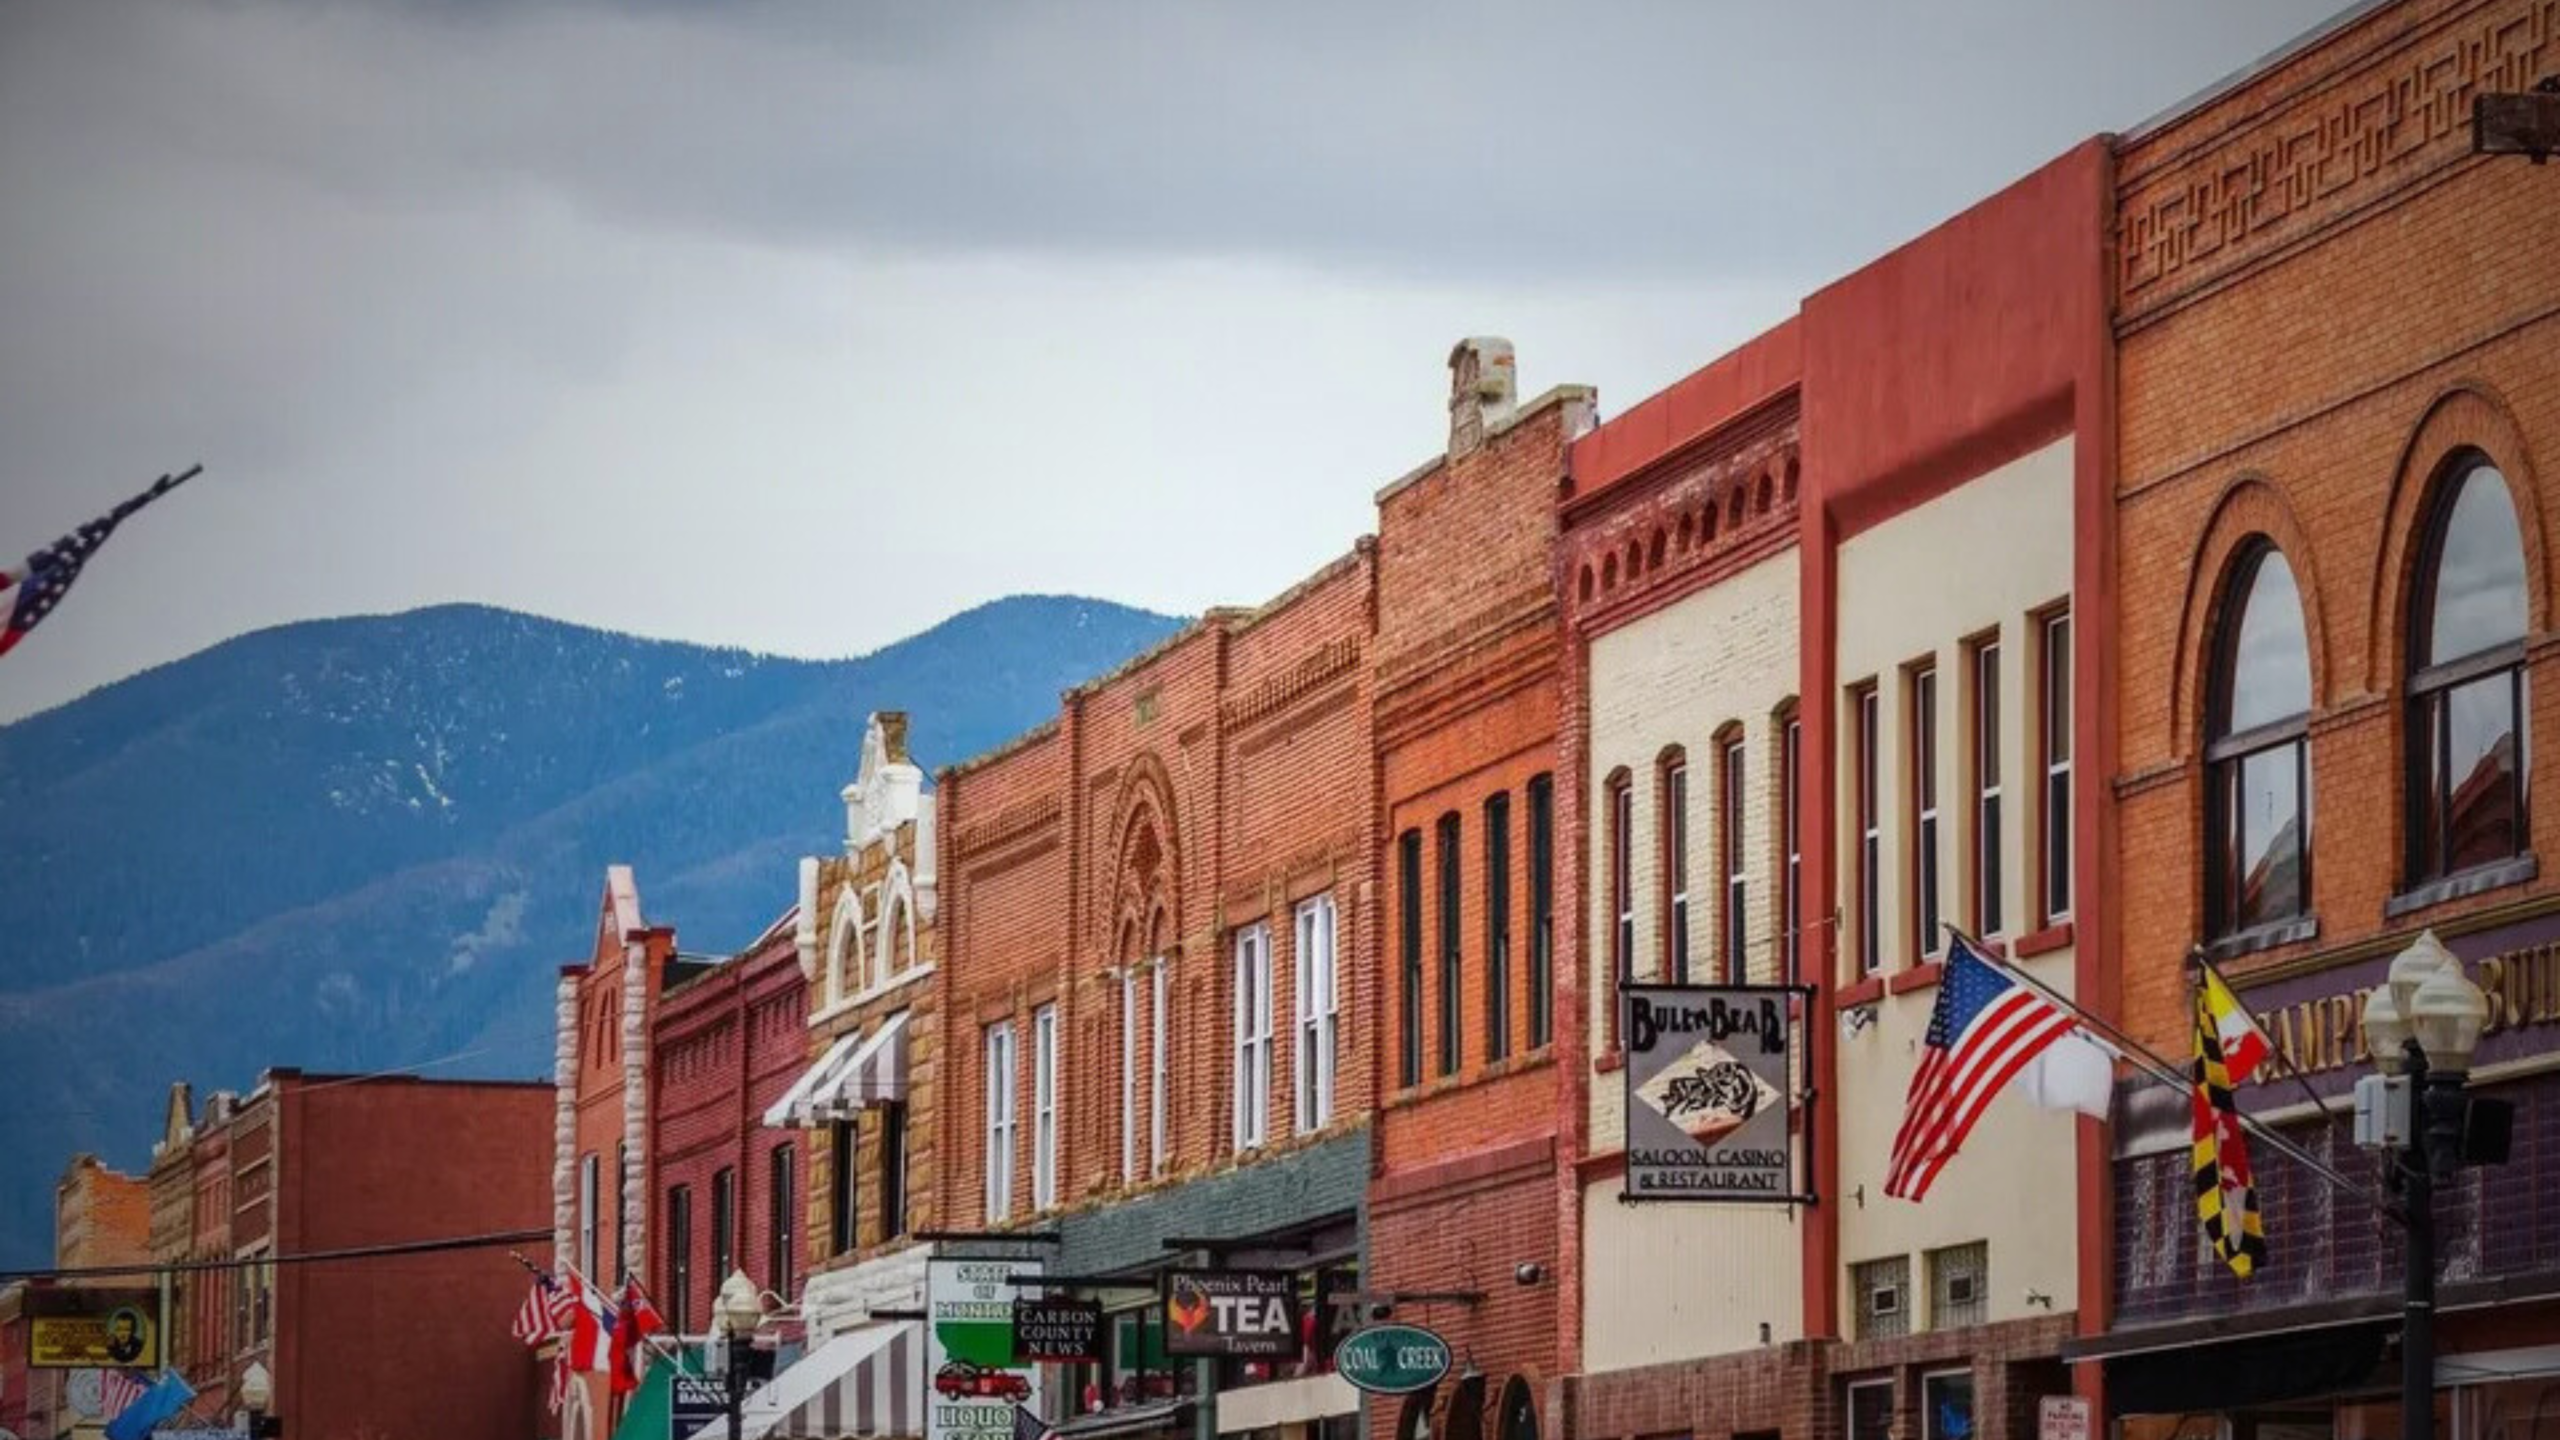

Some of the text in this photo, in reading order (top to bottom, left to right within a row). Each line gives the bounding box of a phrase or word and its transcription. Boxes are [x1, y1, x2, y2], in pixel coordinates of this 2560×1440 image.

[1710, 997, 1784, 1054] BEAR
[1716, 1150, 1785, 1168] CASINO
[1658, 1172, 1779, 1190] RESTAURANT
[1172, 1274, 1289, 1293] Phoenix Pearl
[1020, 1309, 1097, 1324] CARBON
[1210, 1296, 1291, 1335] TEA
[1020, 1326, 1095, 1341] COUNTY
[1028, 1341, 1084, 1356] NEWS
[1222, 1336, 1278, 1353] Tavern
[1341, 1346, 1444, 1370] COAL CREEK
[935, 1405, 1014, 1429] LIQUO
